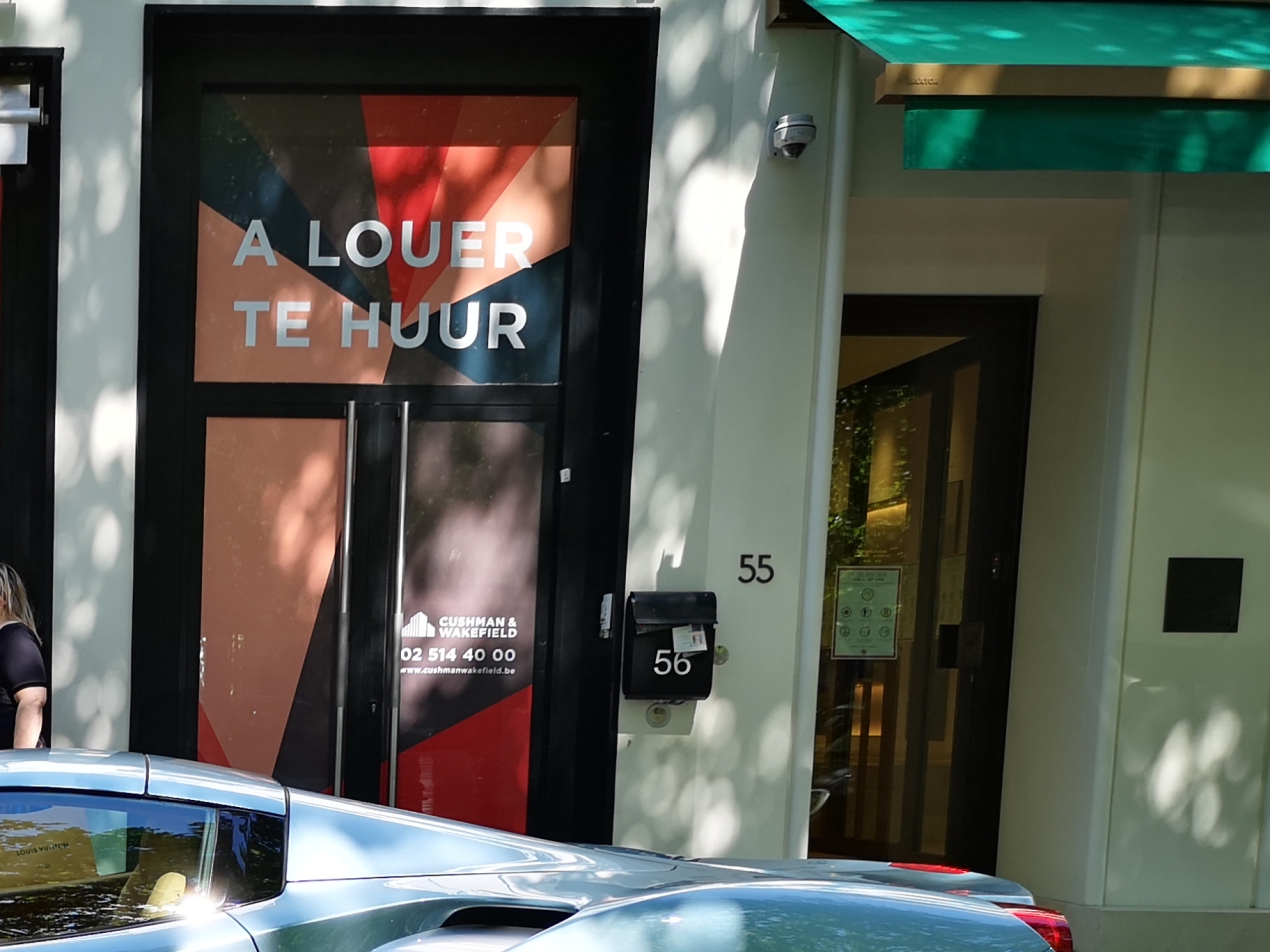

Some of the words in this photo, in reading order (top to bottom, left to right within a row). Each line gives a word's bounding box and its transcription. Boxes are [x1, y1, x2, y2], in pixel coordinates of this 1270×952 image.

[232, 219, 278, 267] A
[307, 219, 533, 269] LOUER
[233, 301, 312, 347] TE
[340, 301, 528, 350] HUUR
[737, 554, 775, 585] 55
[438, 616, 506, 628] CUSHMAN
[507, 616, 518, 628] &
[438, 627, 518, 639] WAKEFIELD
[400, 647, 423, 662] 02
[427, 647, 457, 662] 514
[462, 648, 486, 662] 40
[492, 648, 516, 662] 00
[653, 649, 692, 676] 56
[16, 847, 38, 857] LOUIS
